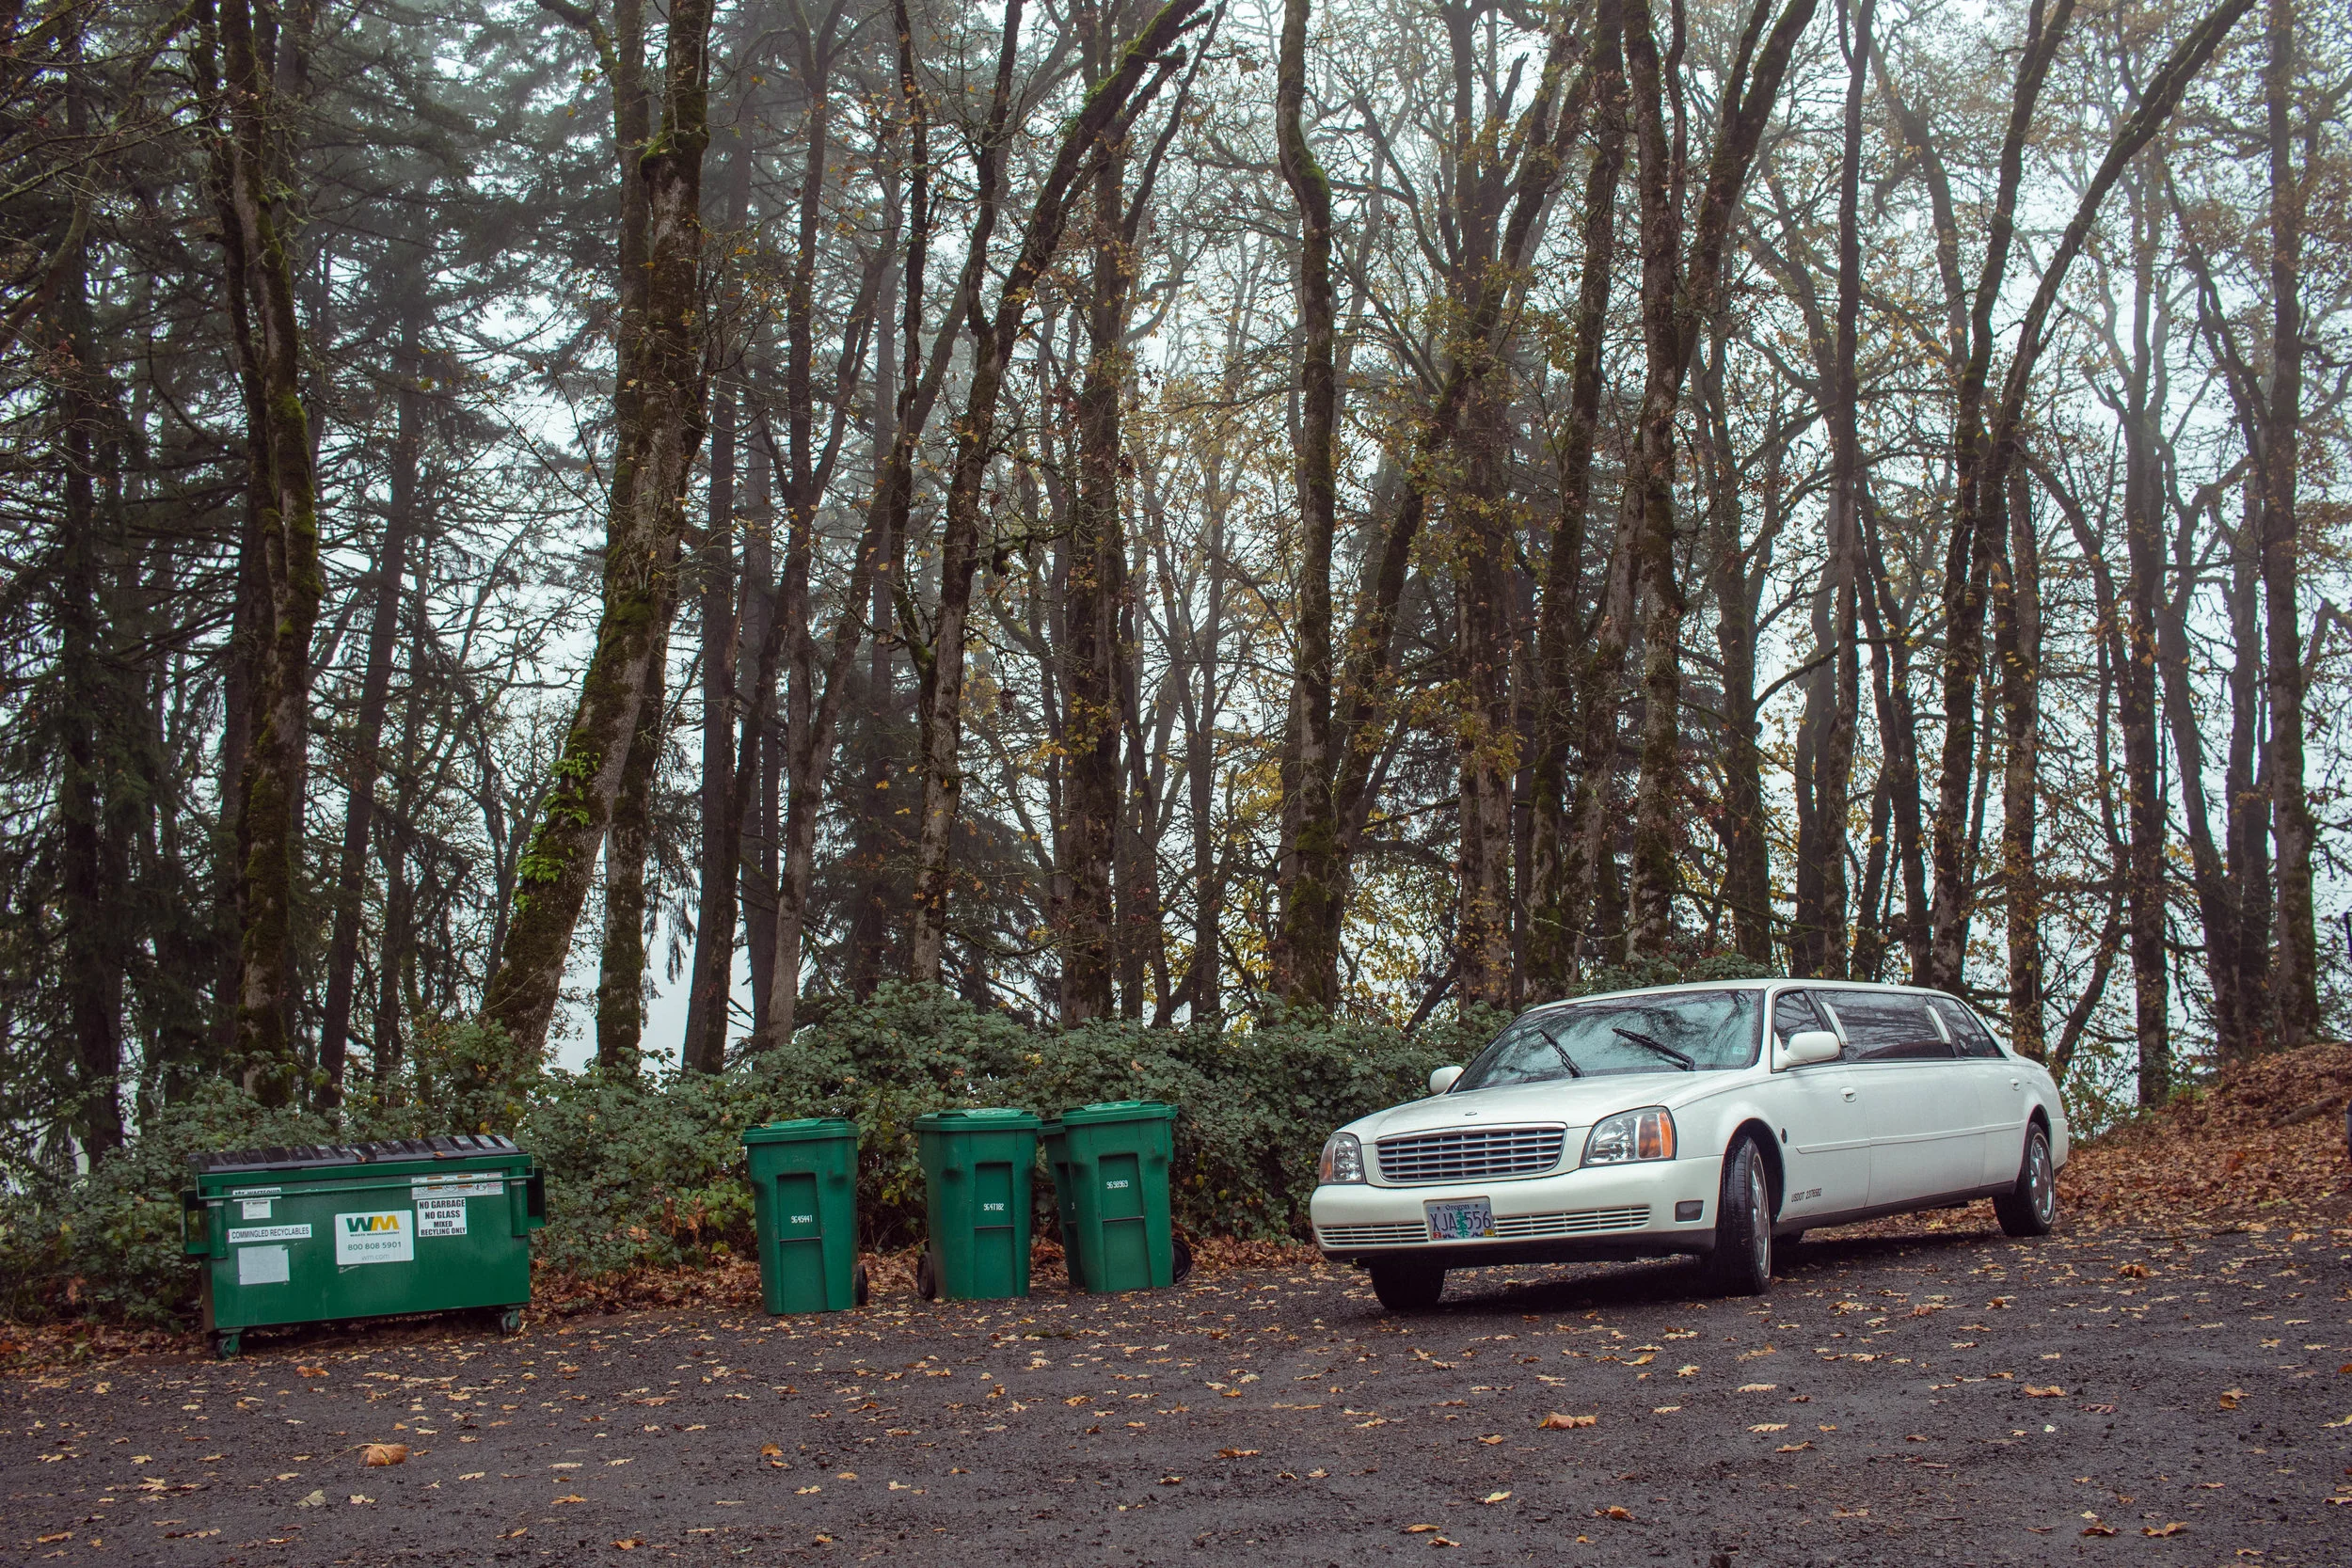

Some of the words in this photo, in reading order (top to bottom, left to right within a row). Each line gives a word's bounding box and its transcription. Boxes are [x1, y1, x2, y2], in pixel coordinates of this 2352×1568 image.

[419, 1200, 430, 1210] NO
[431, 1199, 466, 1209] GARBAGE
[1445, 1203, 1470, 1212] Oregon
[424, 1212, 436, 1220] NO
[437, 1210, 461, 1219] GLASS
[346, 1214, 400, 1233] WM
[433, 1220, 453, 1228] MIXED
[1430, 1212, 1457, 1231] XJA
[1464, 1211, 1491, 1229] 556
[232, 1229, 269, 1239] COMMINGLED
[270, 1227, 310, 1236] RECYCLABLES
[421, 1227, 450, 1236] RECYLING
[451, 1227, 466, 1235] ONLY
[382, 1241, 402, 1249] 5901
